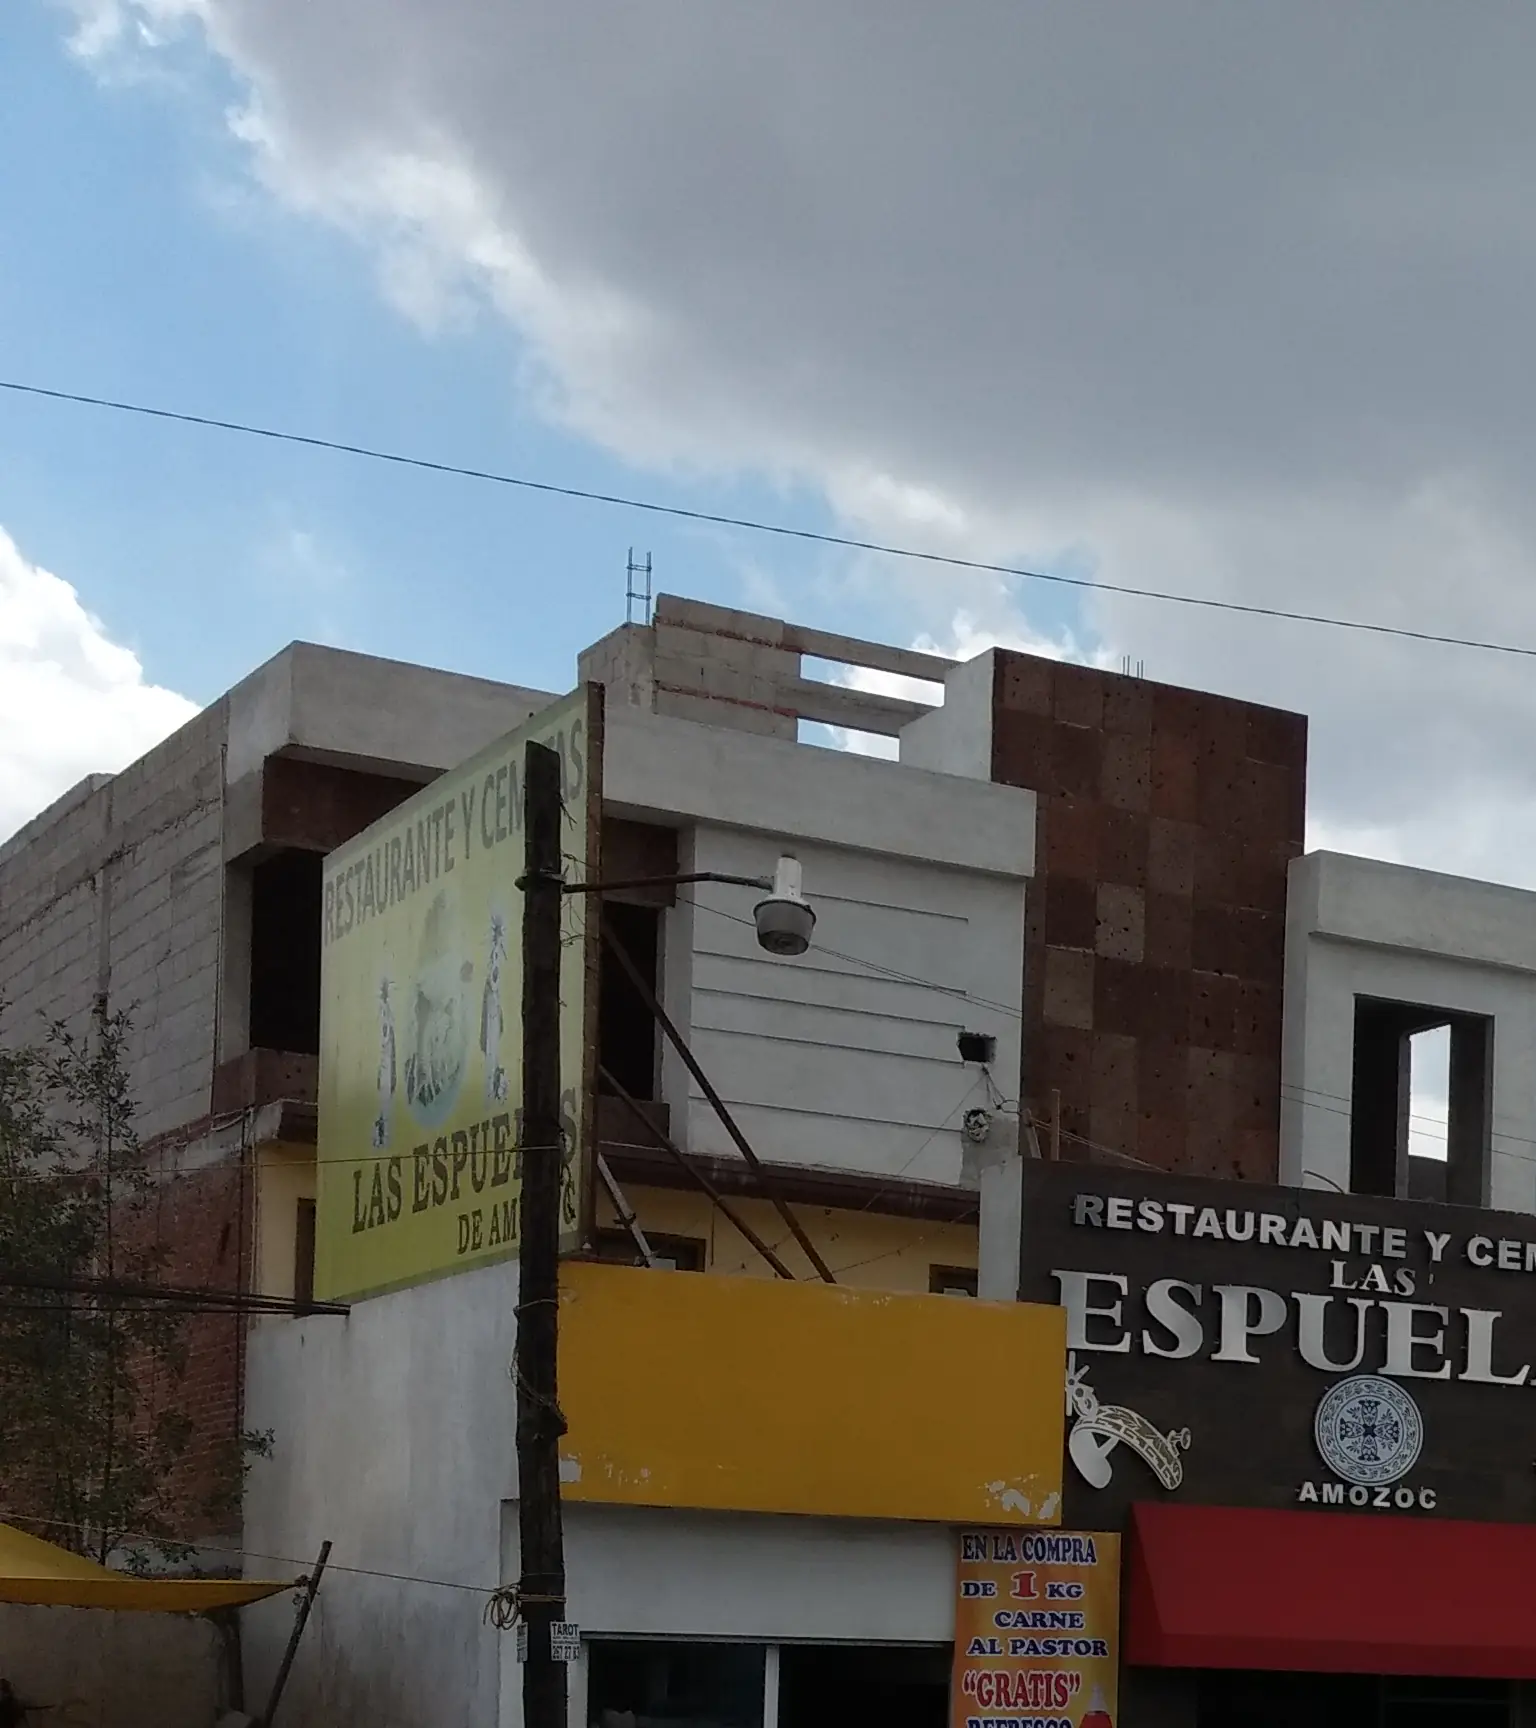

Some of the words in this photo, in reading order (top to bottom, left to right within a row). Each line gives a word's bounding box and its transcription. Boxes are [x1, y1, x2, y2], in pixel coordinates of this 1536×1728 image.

[325, 798, 456, 946] RESTAURANTE
[462, 785, 475, 860] Y
[481, 718, 584, 849] CEMAS
[352, 1156, 402, 1234] LAS
[412, 1088, 577, 1213] ESPUES
[457, 1208, 483, 1255] DE
[1073, 1193, 1408, 1260] RESTAURANTE
[1423, 1230, 1452, 1263] Y
[1329, 1258, 1417, 1297] LAS
[1299, 1480, 1438, 1510] AMOZOC
[962, 1534, 988, 1561] EN
[992, 1536, 1018, 1562] LA
[1022, 1536, 1098, 1564] COMPRA
[962, 1581, 996, 1597] DE
[1011, 1571, 1038, 1598] 1
[1046, 1583, 1084, 1599] KG
[551, 1623, 579, 1636] TAROT
[994, 1611, 1085, 1630] CARNE
[967, 1638, 1003, 1656] AL
[1009, 1638, 1109, 1657] PASTOR
